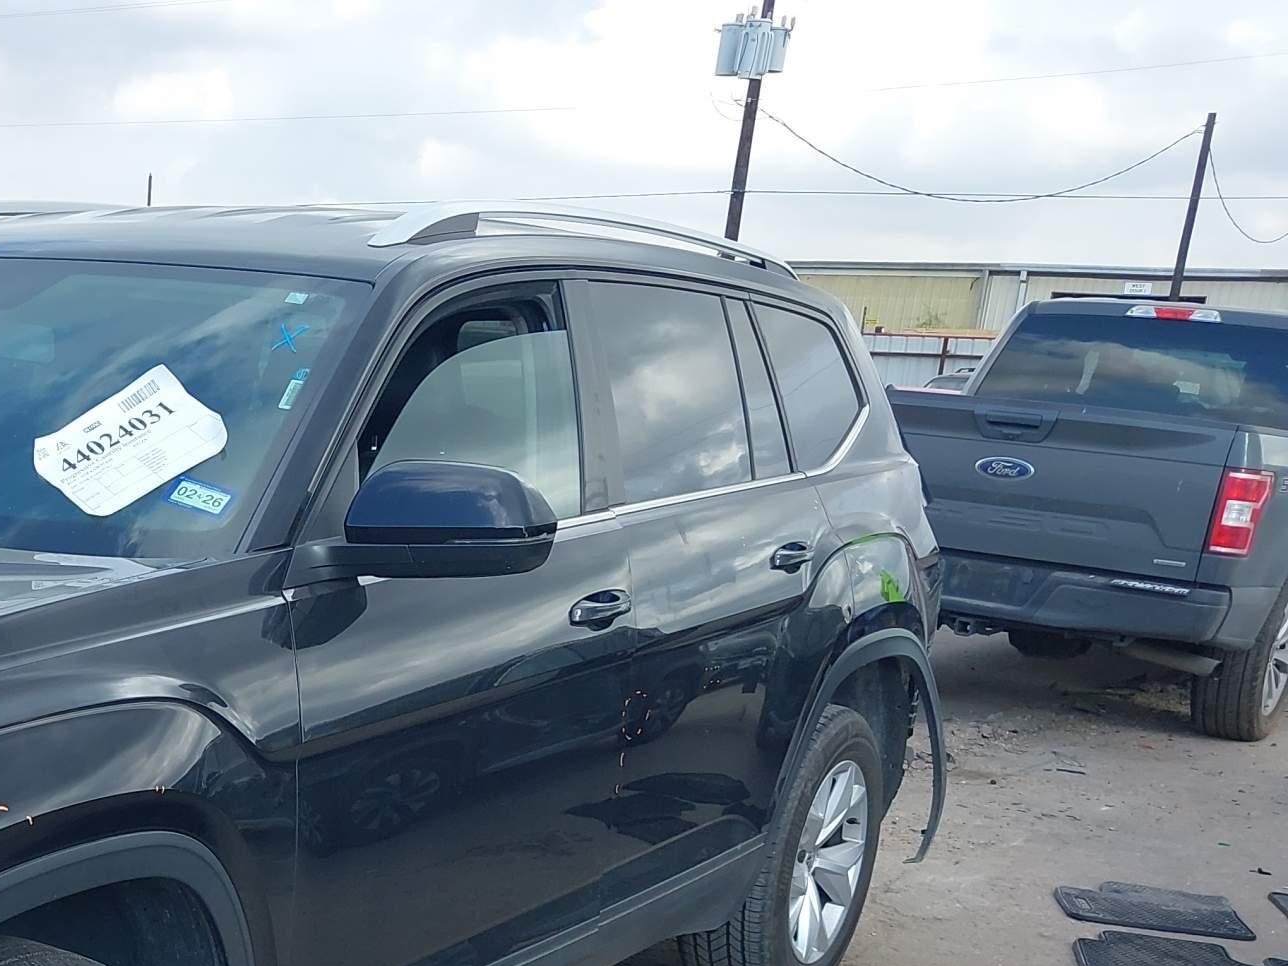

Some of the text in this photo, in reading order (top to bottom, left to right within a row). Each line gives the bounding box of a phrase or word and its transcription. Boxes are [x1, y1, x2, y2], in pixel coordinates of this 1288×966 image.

[61, 401, 176, 472] 44024031
[987, 461, 1020, 477] Ford
[176, 486, 224, 508] 02 26
